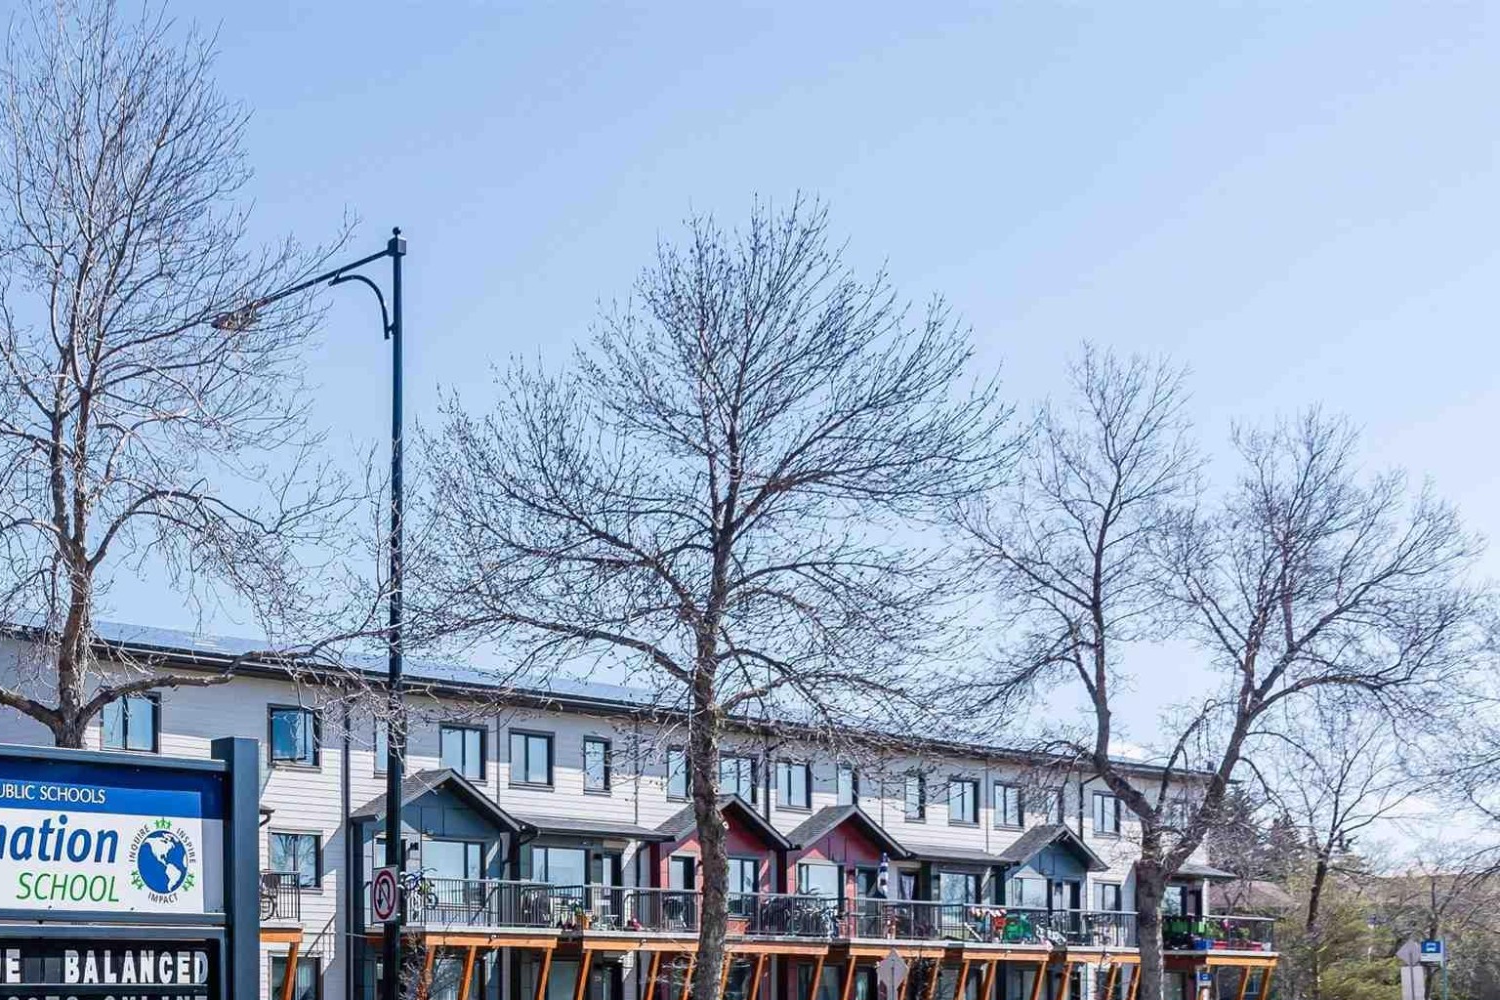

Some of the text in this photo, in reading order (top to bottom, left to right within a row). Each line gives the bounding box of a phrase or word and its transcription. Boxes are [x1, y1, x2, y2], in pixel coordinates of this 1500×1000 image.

[39, 785, 106, 804] SCHOOLS
[176, 827, 196, 864] INSPIRE
[16, 872, 120, 903] SCHOOL
[147, 891, 179, 904] IMPACT
[64, 949, 209, 984] BALANCED
